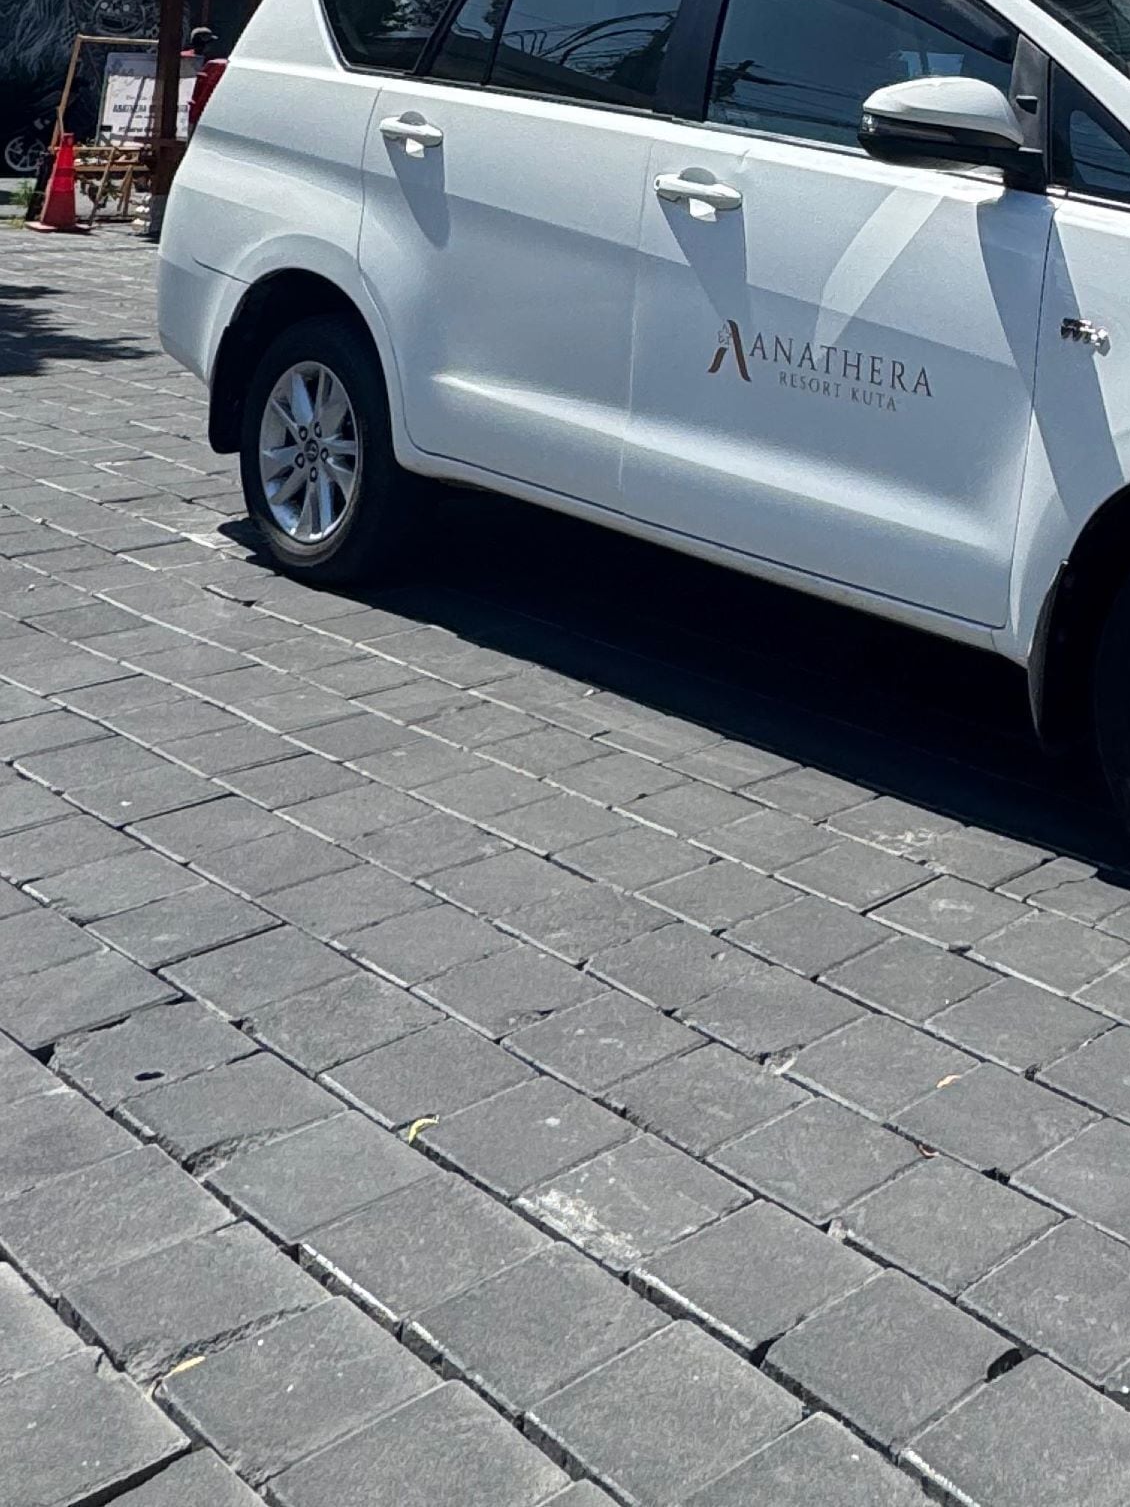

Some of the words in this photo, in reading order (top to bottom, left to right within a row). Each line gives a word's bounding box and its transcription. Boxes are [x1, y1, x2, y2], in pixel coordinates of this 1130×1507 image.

[750, 331, 934, 398] ANATHERA
[779, 371, 842, 398] RESORT
[851, 387, 897, 412] KUTA
